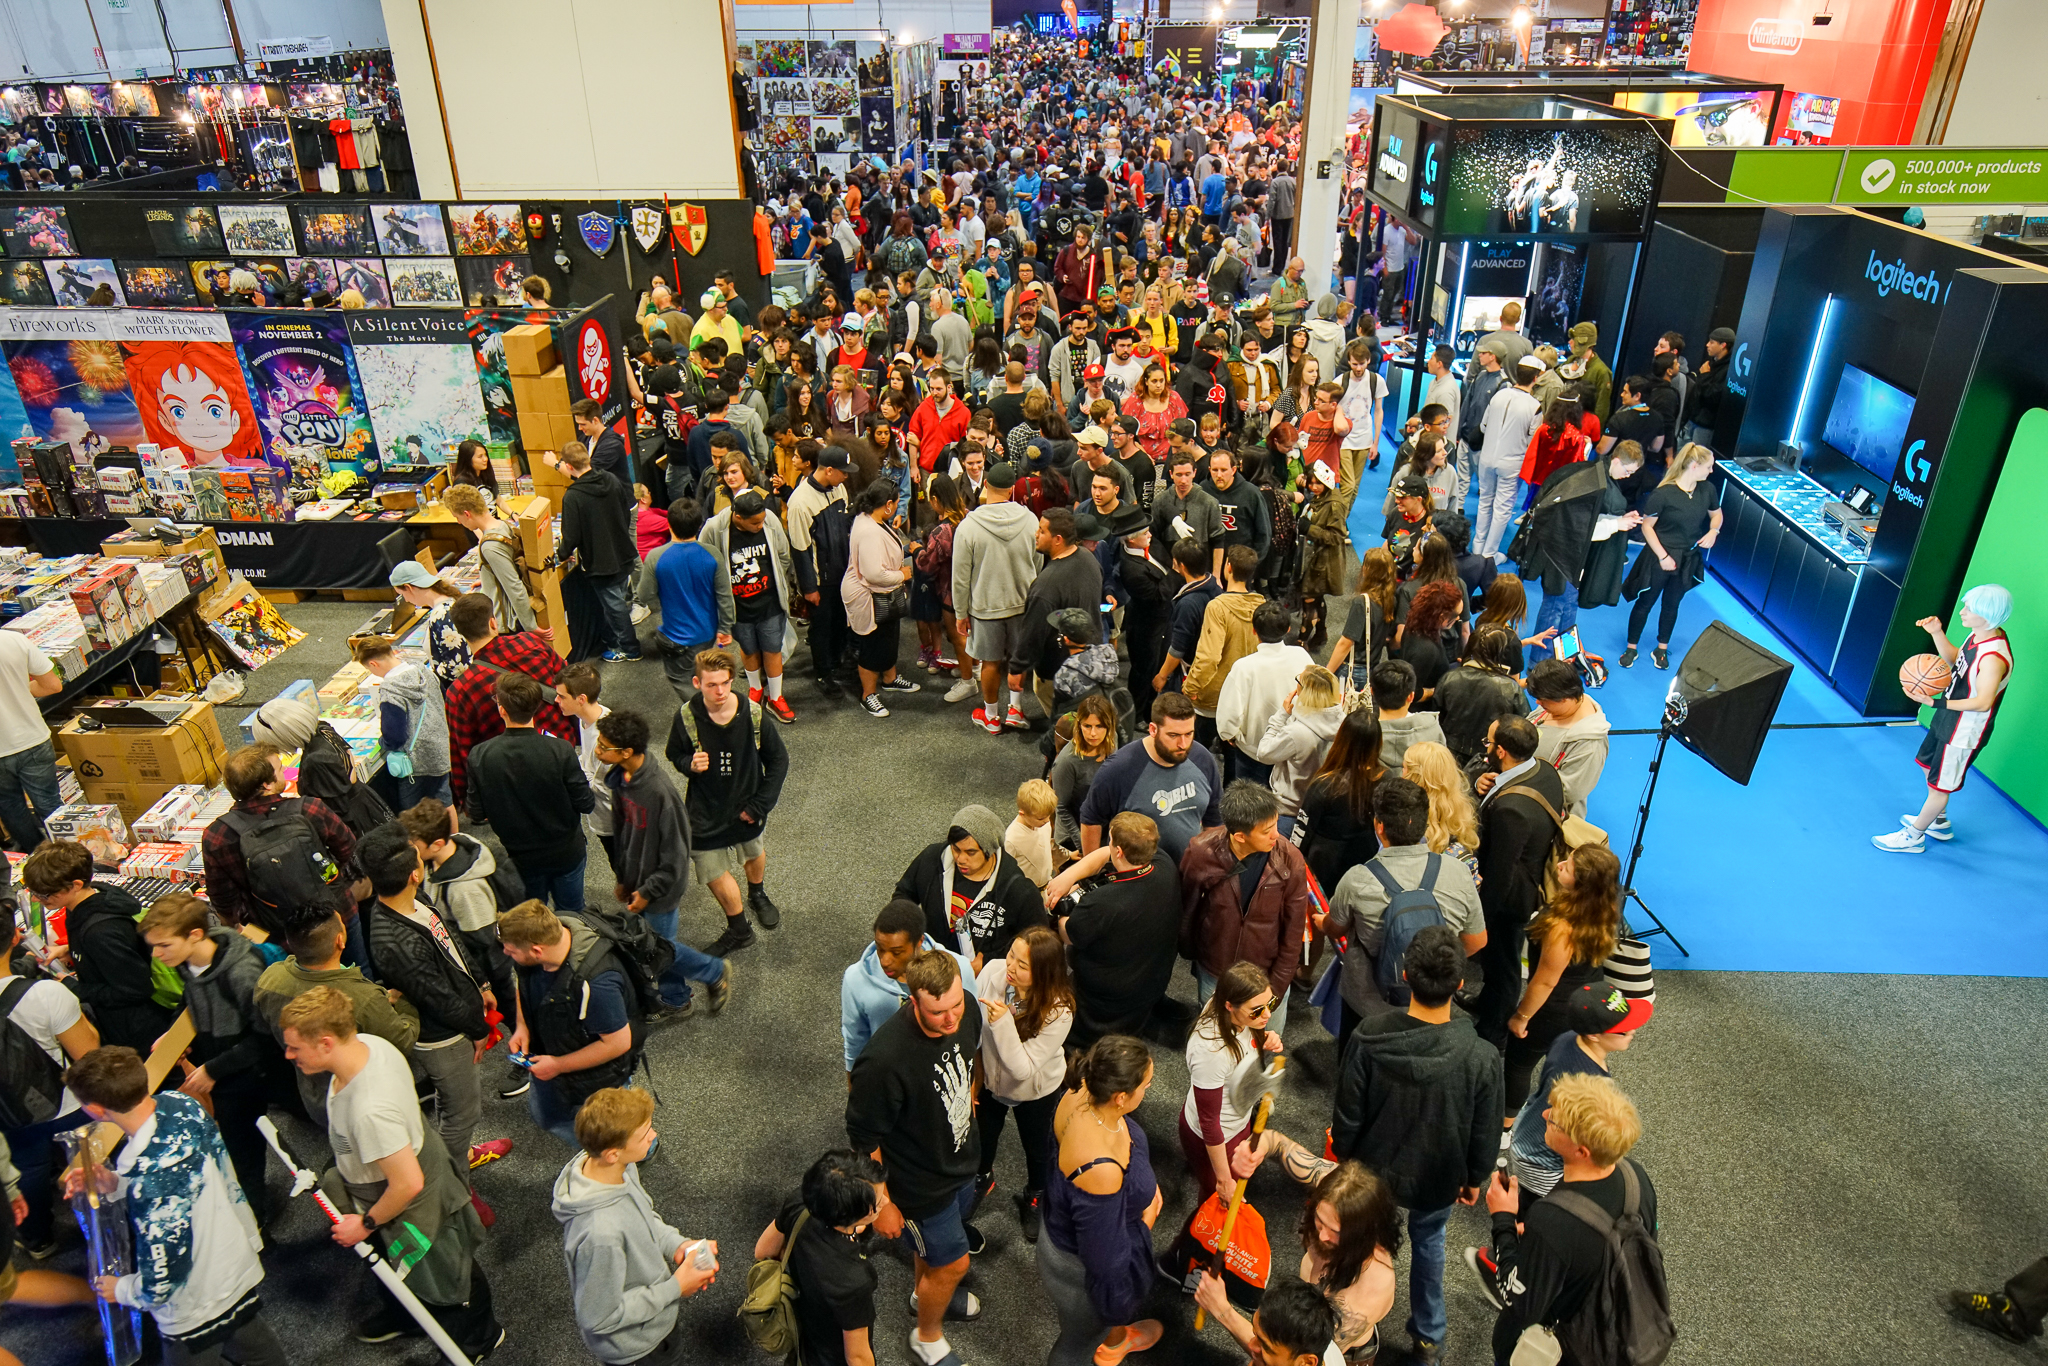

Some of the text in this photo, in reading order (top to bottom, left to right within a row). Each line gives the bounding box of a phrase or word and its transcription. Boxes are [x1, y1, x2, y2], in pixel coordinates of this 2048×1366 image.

[1752, 26, 1797, 47] Nintendo
[1905, 159, 2042, 177] 500,000+ products
[1899, 180, 1991, 193] in stock now
[1488, 249, 1512, 258] PLAY
[387, 263, 455, 271] OVERWATCH
[1471, 259, 1526, 268] ADVANCED
[1865, 249, 1939, 304] logitech
[9, 316, 96, 332] Fireworks
[135, 316, 166, 325] MARY
[353, 317, 465, 331] A Silent Voice
[124, 325, 216, 336] WITCH'S FLOWER
[258, 331, 314, 339] NOVEMBER
[252, 350, 273, 367] DISCOVER
[276, 347, 302, 355] DIFFERENT
[303, 347, 321, 356] BREED
[329, 355, 344, 366] HERO
[1726, 377, 1746, 397] logitech
[284, 413, 328, 421] my LITTLE
[282, 418, 346, 447] PONY
[1892, 481, 1924, 508] logitech
[742, 544, 766, 558] WHY
[731, 575, 741, 584] SO
[1231, 1259, 1259, 1280] STORE
